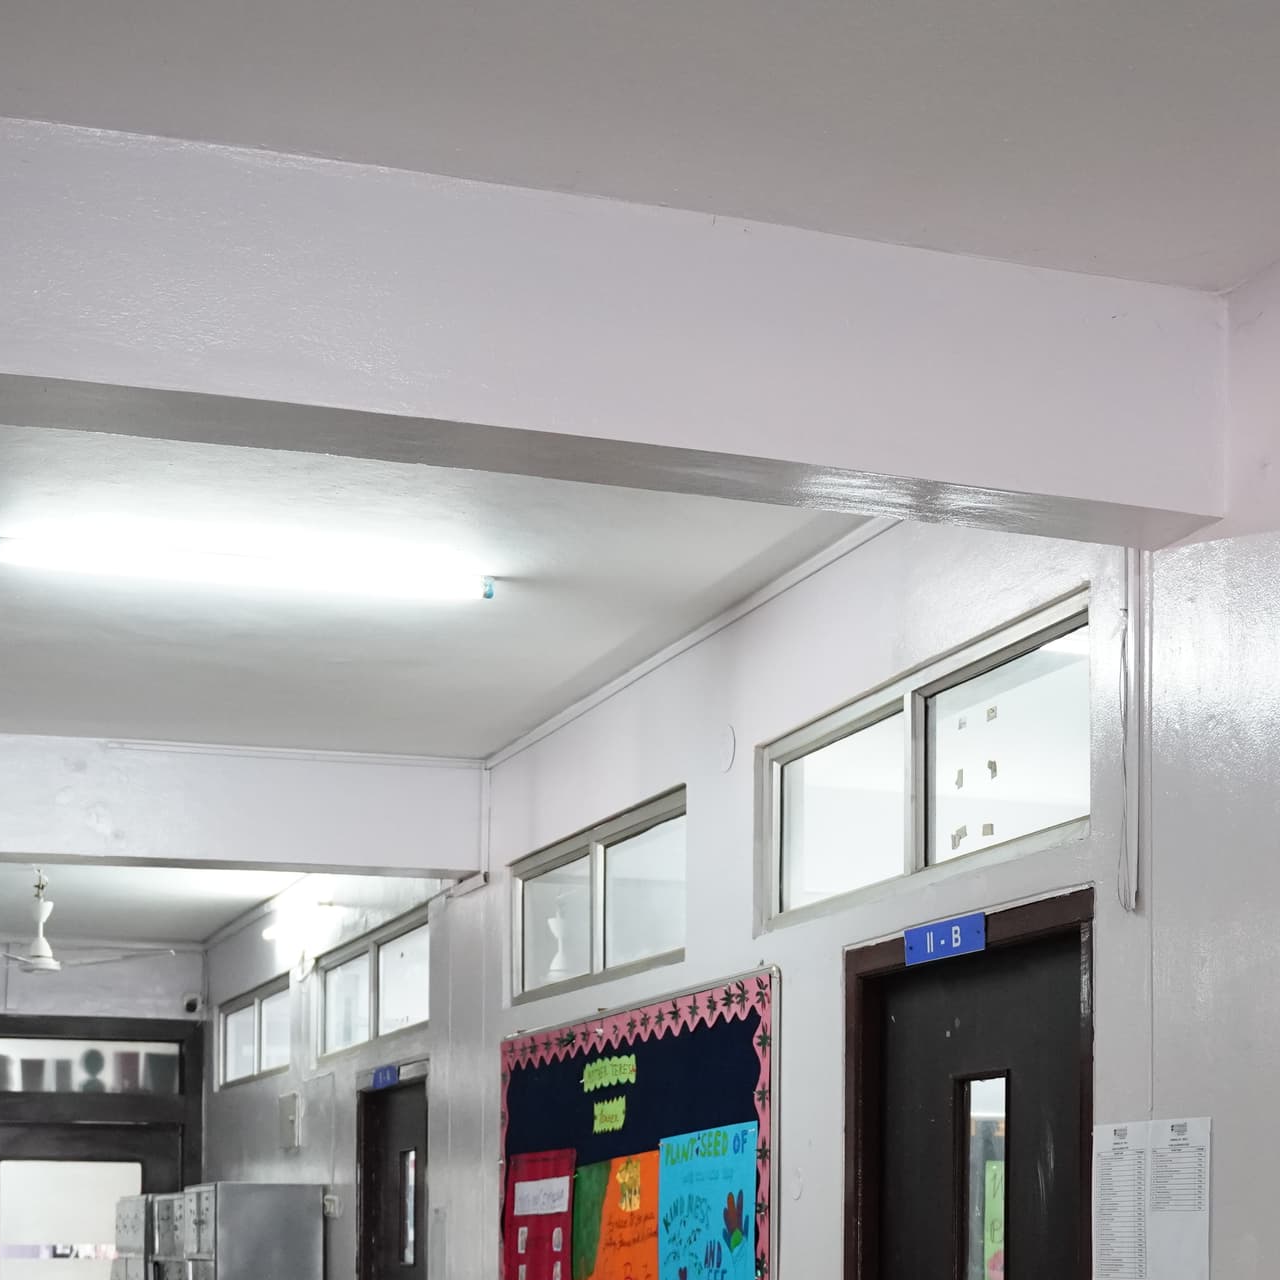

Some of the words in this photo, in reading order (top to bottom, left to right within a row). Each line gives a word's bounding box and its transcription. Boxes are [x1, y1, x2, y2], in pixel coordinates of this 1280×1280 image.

[951, 925, 961, 948] B
[664, 1137, 697, 1167] PLANT
[700, 1129, 729, 1158] SEED
[733, 1129, 748, 1154] OF
[704, 1239, 722, 1269] AND
